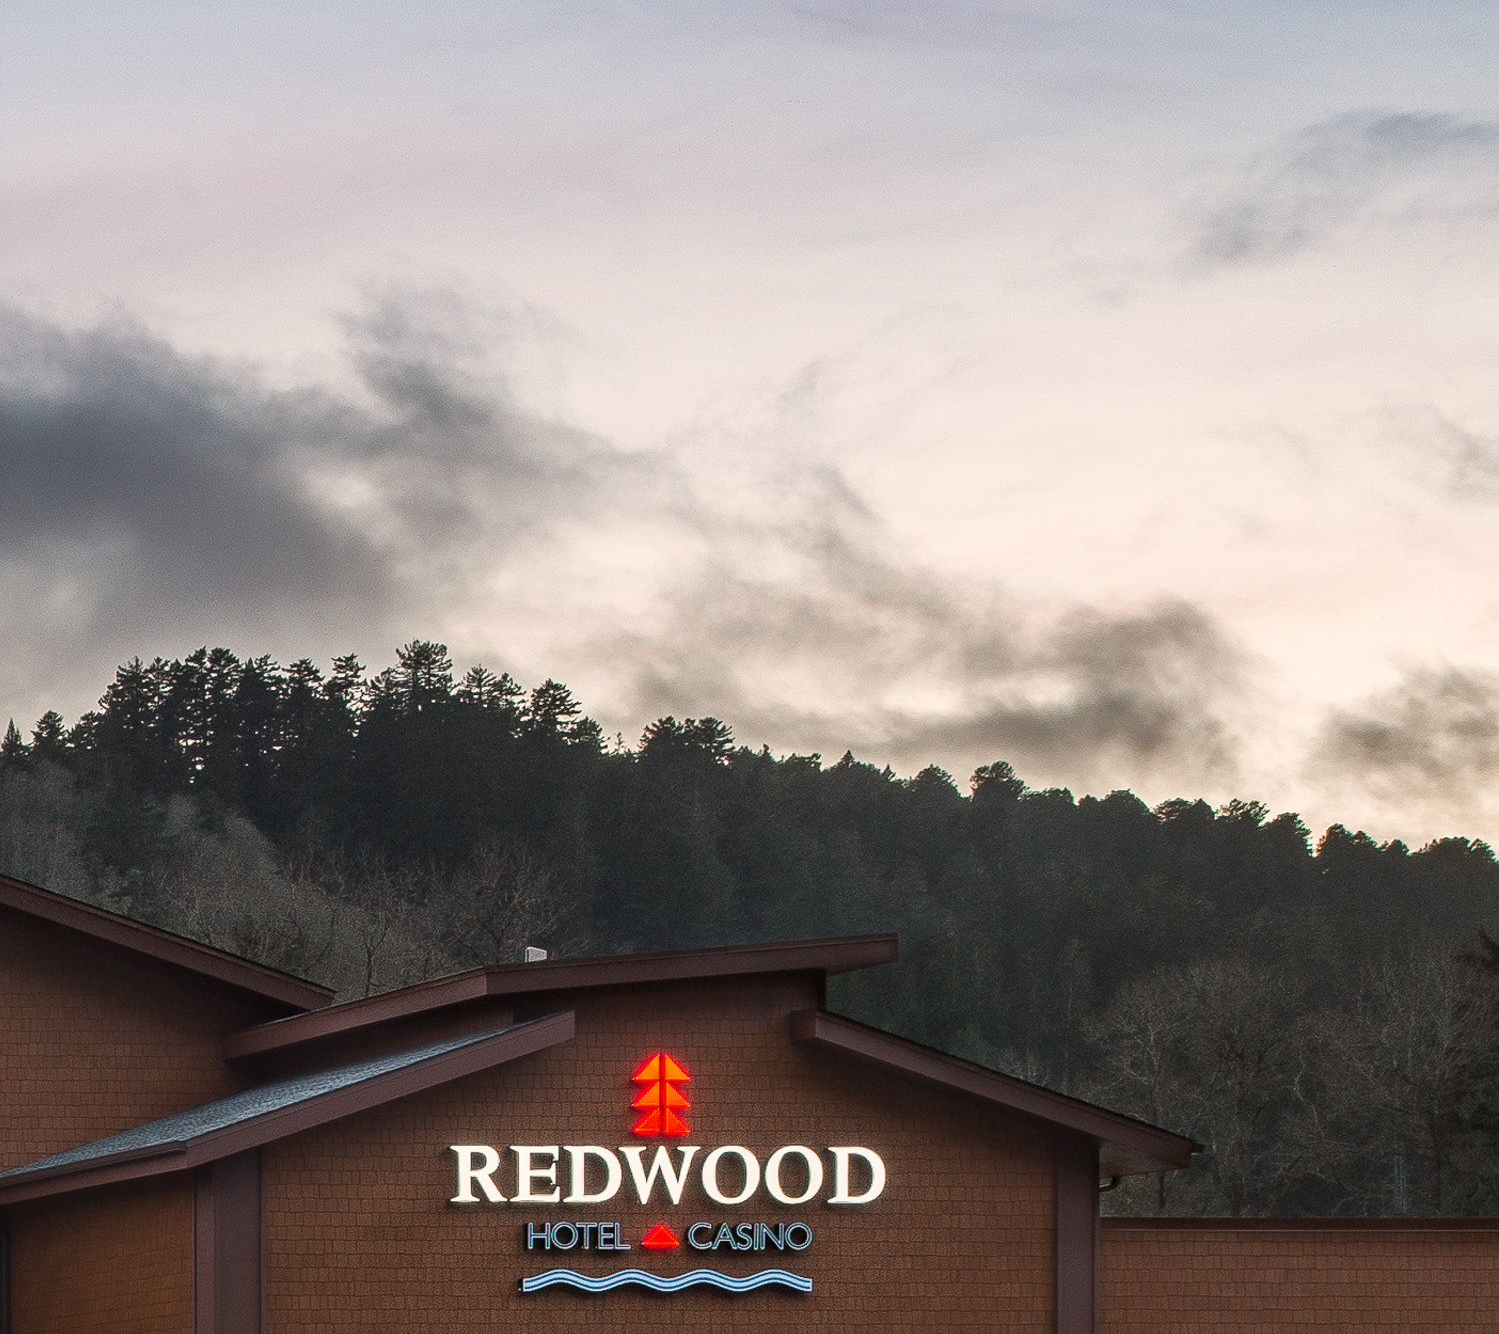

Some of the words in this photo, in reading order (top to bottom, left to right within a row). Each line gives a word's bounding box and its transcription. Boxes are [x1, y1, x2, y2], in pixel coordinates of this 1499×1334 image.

[449, 1144, 887, 1206] REDWOOD
[526, 1221, 631, 1251] HOTEL
[687, 1221, 813, 1251] CASINO
